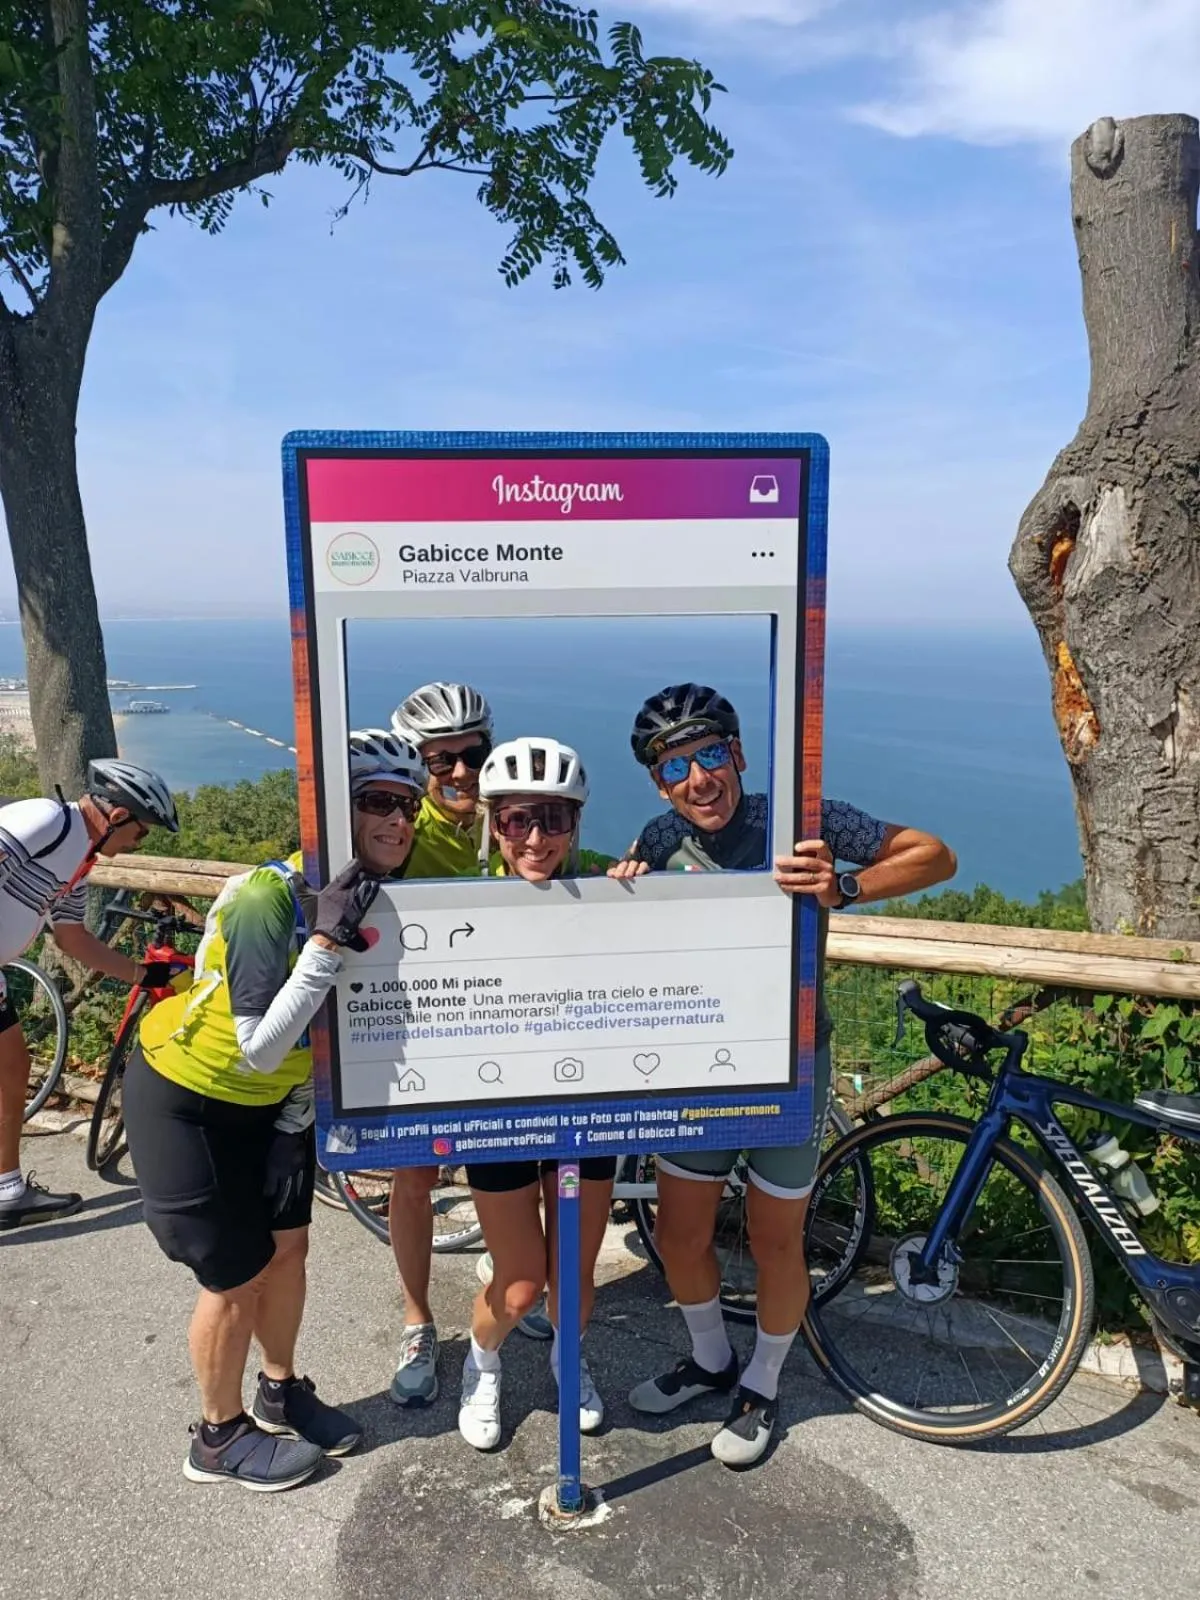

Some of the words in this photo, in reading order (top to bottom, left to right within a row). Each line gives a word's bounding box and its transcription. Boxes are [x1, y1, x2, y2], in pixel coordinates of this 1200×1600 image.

[492, 474, 624, 513] Instagram
[399, 544, 489, 562] Gabicce
[496, 543, 564, 561] Monte
[402, 569, 455, 583] Piazza
[459, 568, 529, 583] Valbruna
[347, 998, 412, 1013] Gabicce
[417, 995, 467, 1009] Monte
[473, 993, 504, 1006] Una
[508, 988, 583, 1005] meraviglia
[588, 989, 607, 1001] tra
[611, 986, 645, 999] cielo
[649, 987, 658, 997] e
[662, 984, 704, 997] mare:
[369, 979, 438, 994] 1.000.000
[442, 977, 459, 989] Mi
[463, 976, 502, 991] piace
[350, 1011, 432, 1031] impossibile
[437, 1013, 465, 1023] non
[469, 1004, 559, 1021] innamorarsi!
[564, 997, 721, 1018] #gabiccemaremonte
[352, 1022, 520, 1044] #rivieradelsanbartolo
[524, 1013, 725, 1035] #gabiccediversapernatura
[360, 1127, 389, 1140] Segui
[431, 1122, 462, 1134] social
[506, 1121, 513, 1130] e
[515, 1115, 558, 1129] condividi
[560, 1115, 570, 1127] le
[572, 1114, 588, 1125] tue
[614, 1112, 632, 1123] con
[634, 1108, 679, 1122] l'hashtag
[681, 1104, 781, 1120] #gabiccemaremonte
[455, 1133, 556, 1152] gabiccemareofficial
[587, 1128, 625, 1142] Comune
[627, 1127, 637, 1140] di
[638, 1125, 676, 1139] Gabicce
[678, 1124, 704, 1137] Mare
[1035, 1122, 1147, 1255] SPECIALIZED
[1038, 1360, 1050, 1377] DT
[1047, 1335, 1064, 1363] SWISS
